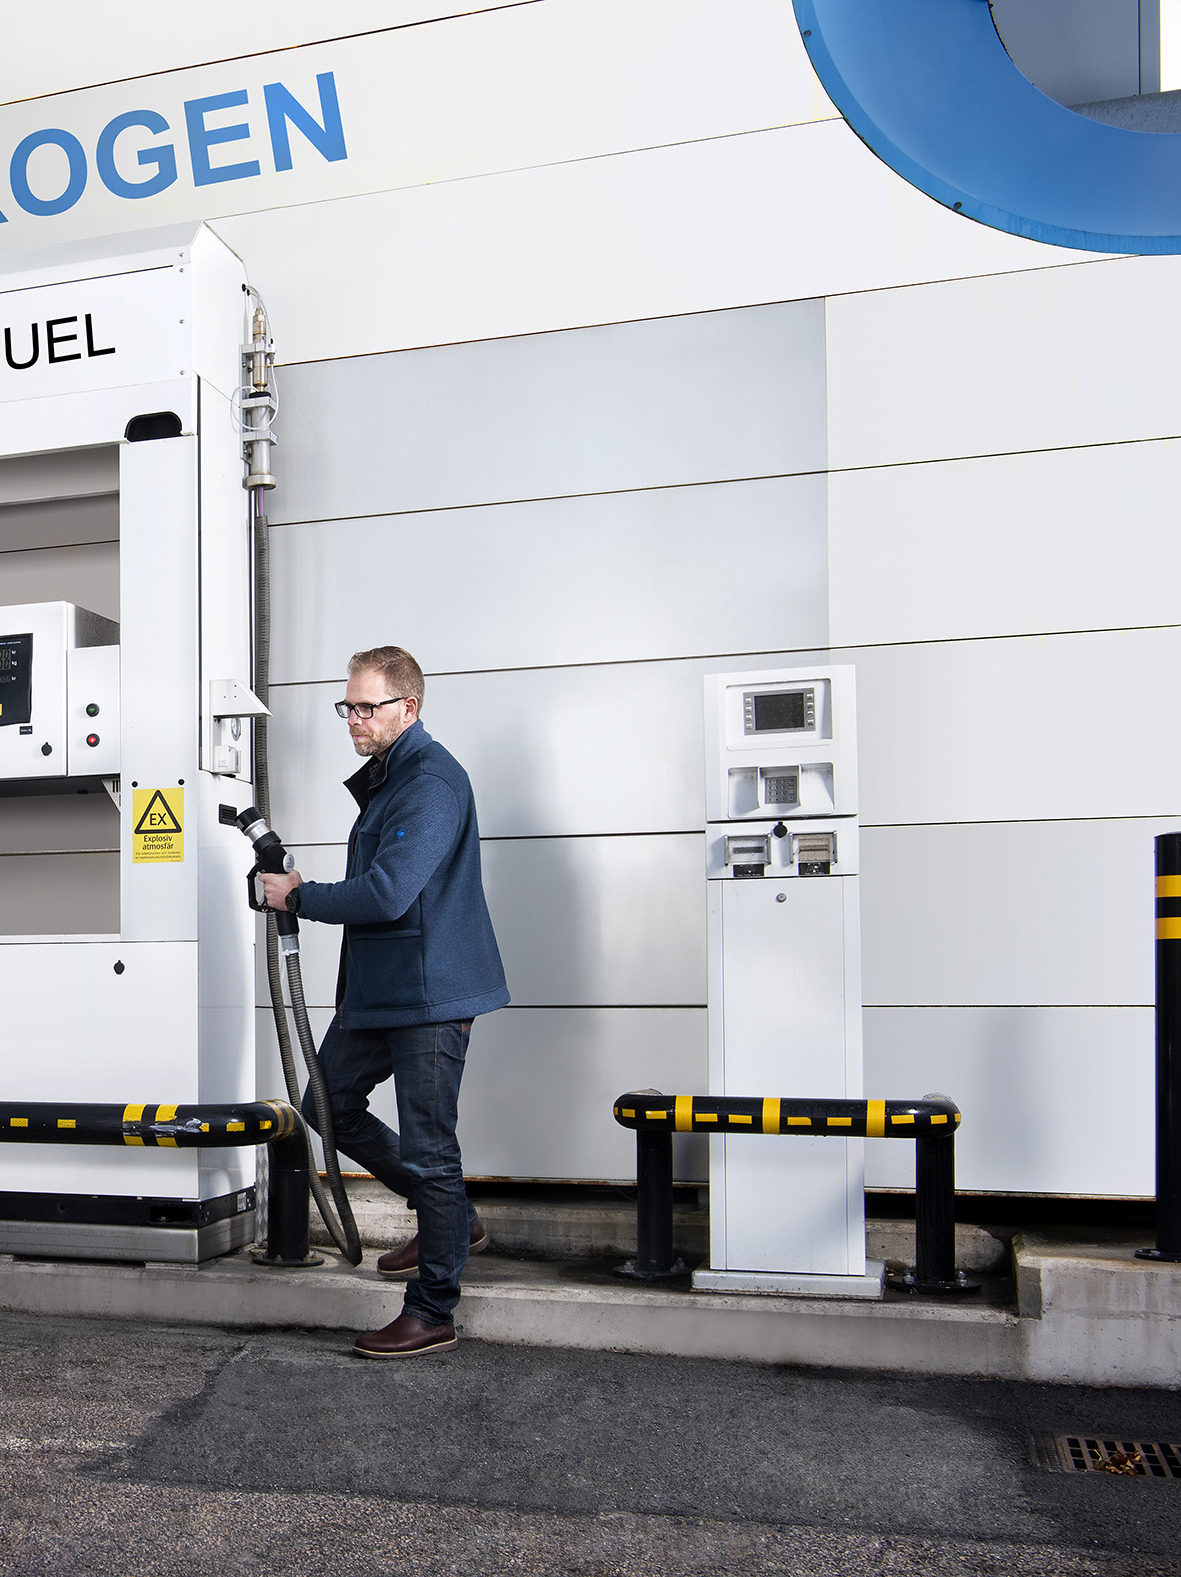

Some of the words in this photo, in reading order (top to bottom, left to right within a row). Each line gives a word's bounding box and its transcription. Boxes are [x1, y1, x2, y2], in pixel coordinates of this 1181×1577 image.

[149, 812, 167, 826] EX
[143, 835, 173, 843] Explosiv
[142, 842, 174, 850] atmosfär
